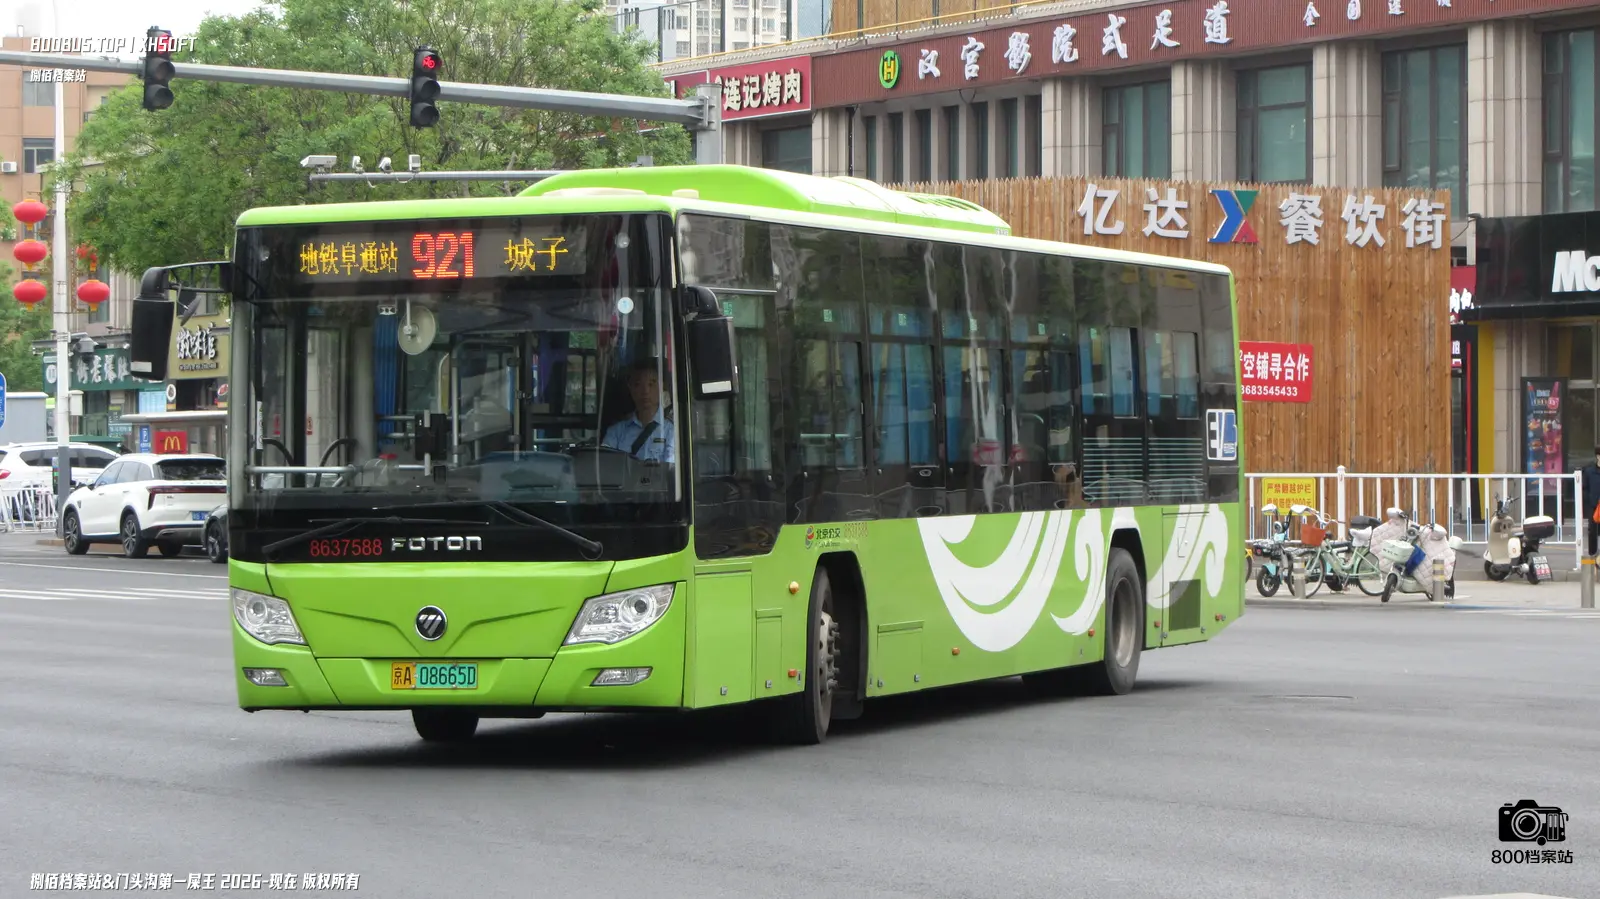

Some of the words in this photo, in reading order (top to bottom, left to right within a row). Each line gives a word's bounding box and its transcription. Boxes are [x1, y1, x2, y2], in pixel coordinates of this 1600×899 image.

[1302, 0, 1452, 27] 全国连
[715, 68, 801, 111] 连记烤肉
[1077, 183, 1189, 239] 亿达
[1278, 192, 1446, 249] 餐饮街
[300, 240, 398, 275] 地铁阜通站
[412, 232, 475, 278] 921
[503, 236, 569, 272] 城子
[310, 538, 383, 557] 8637588
[391, 536, 483, 551] FOTON
[393, 666, 412, 685] 京A
[419, 666, 477, 686] 08665D
